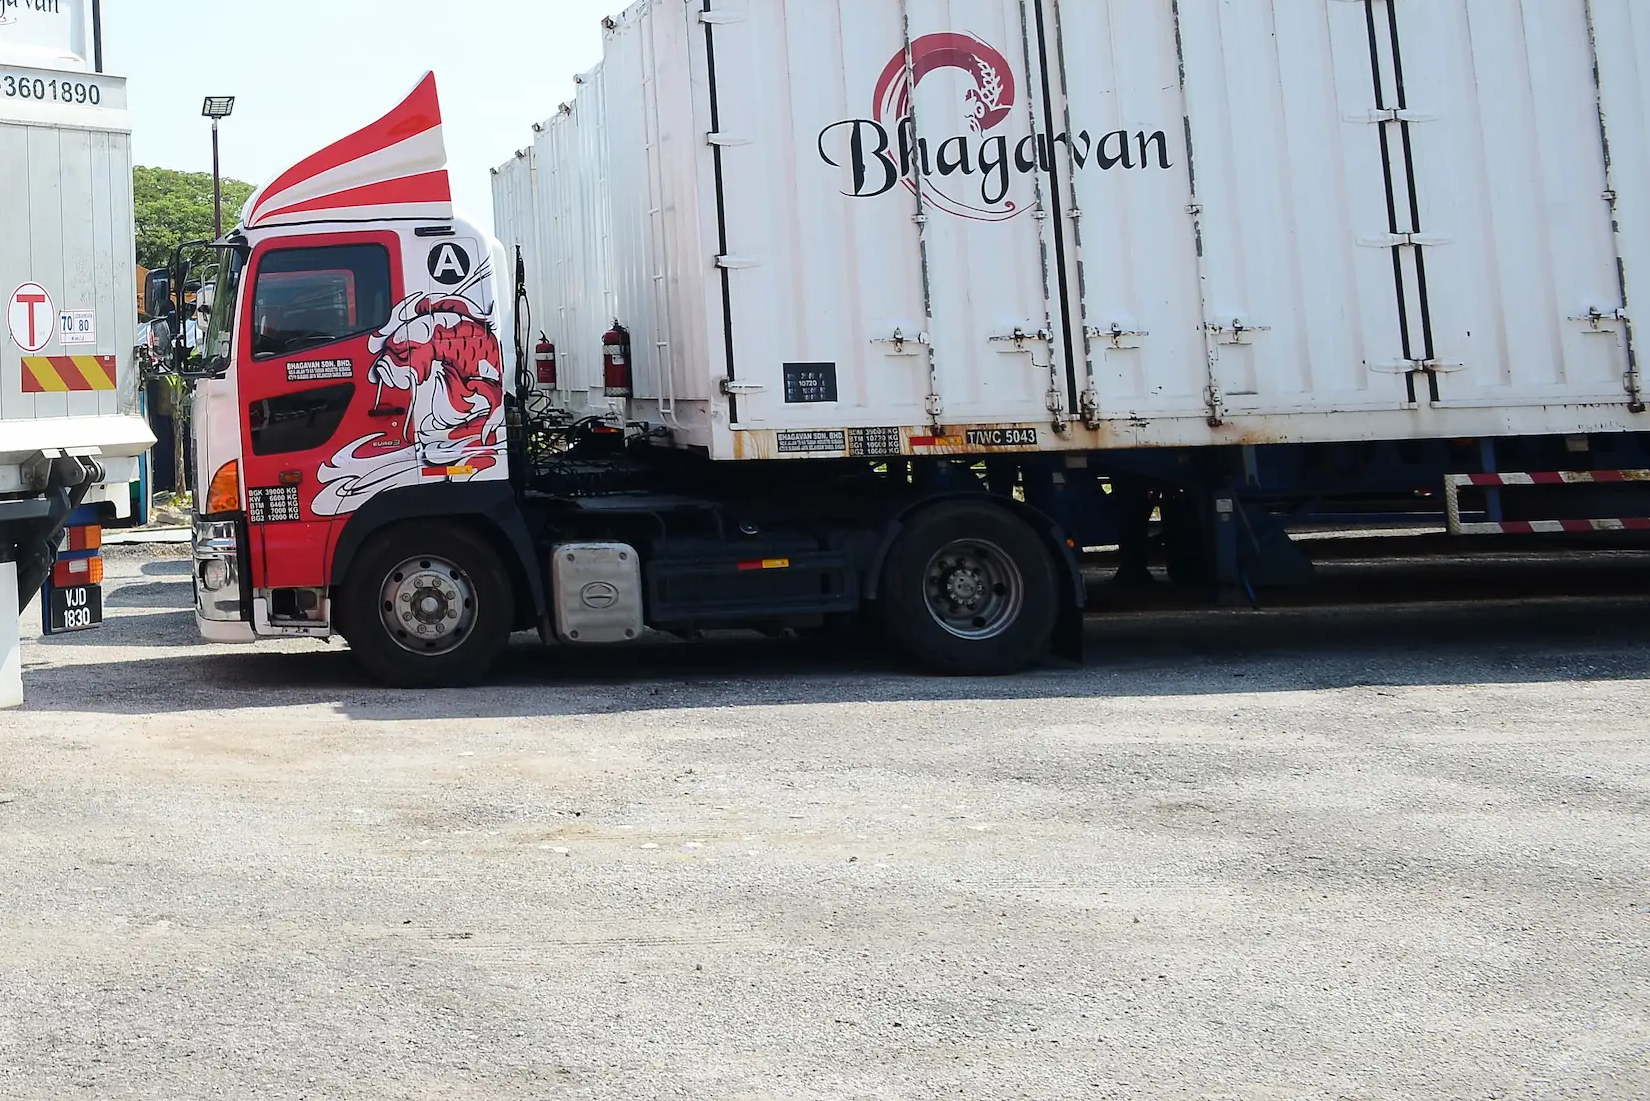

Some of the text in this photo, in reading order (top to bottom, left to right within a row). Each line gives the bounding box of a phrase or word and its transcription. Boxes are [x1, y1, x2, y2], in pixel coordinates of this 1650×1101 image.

[433, 244, 465, 277] A
[16, 294, 45, 347] T
[61, 315, 73, 331] 70
[78, 319, 89, 331] 80
[286, 361, 320, 370] BHAGAVAN
[778, 433, 812, 441] BHAGAVAN
[967, 429, 1036, 445] T/WC 5043
[65, 587, 87, 607] VJD
[63, 607, 90, 628] 1830
